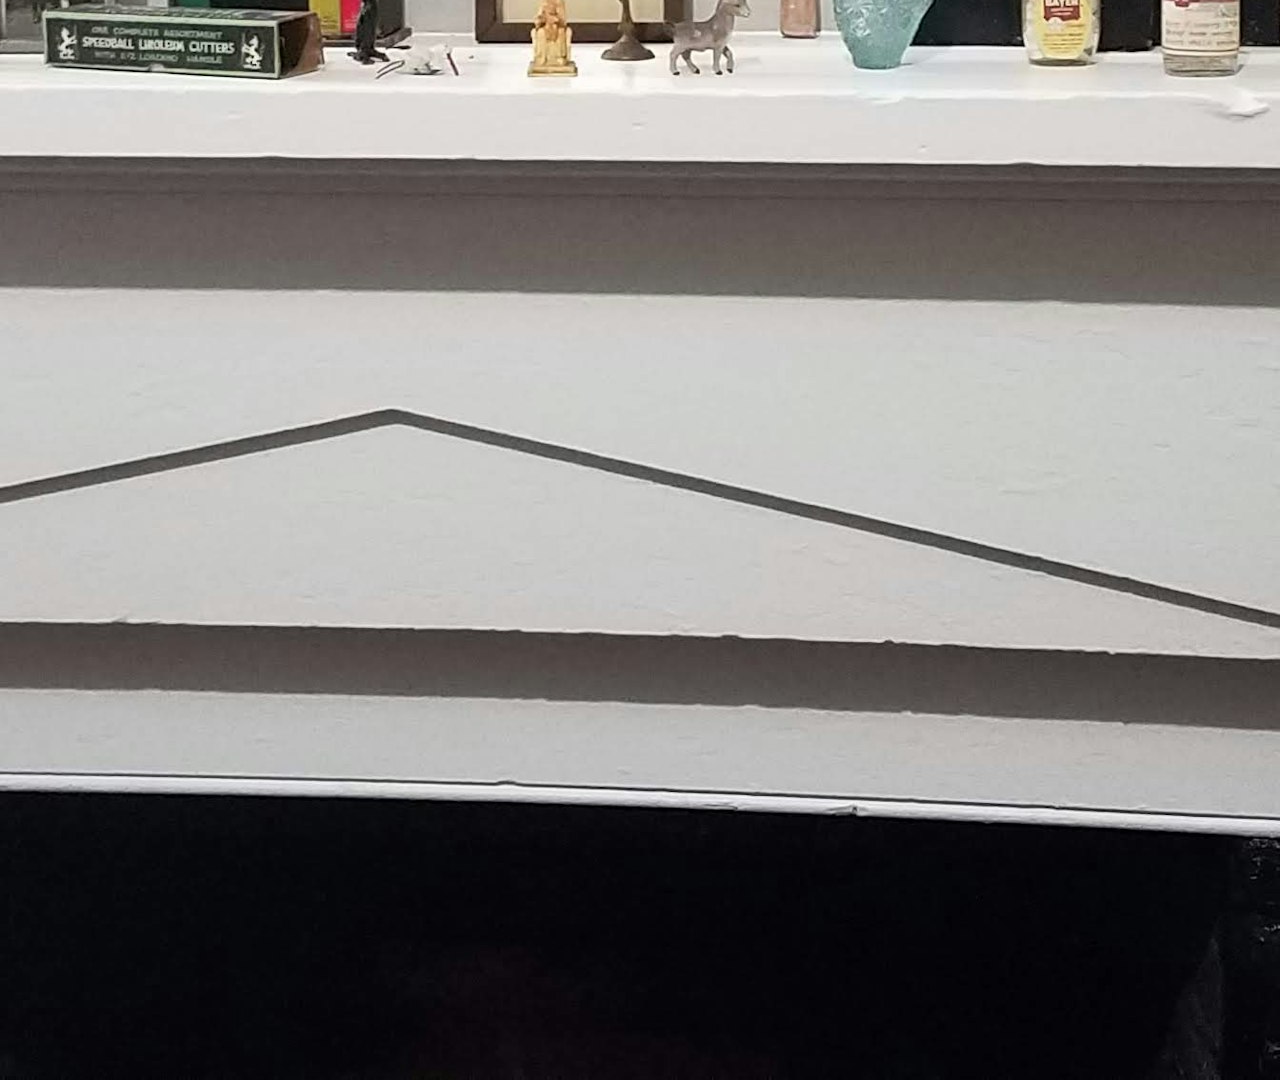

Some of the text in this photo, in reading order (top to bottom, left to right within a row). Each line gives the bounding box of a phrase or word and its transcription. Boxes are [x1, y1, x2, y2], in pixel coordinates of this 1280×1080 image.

[82, 36, 236, 55] SPEEDBALL LINOLEUM CUTTERS
